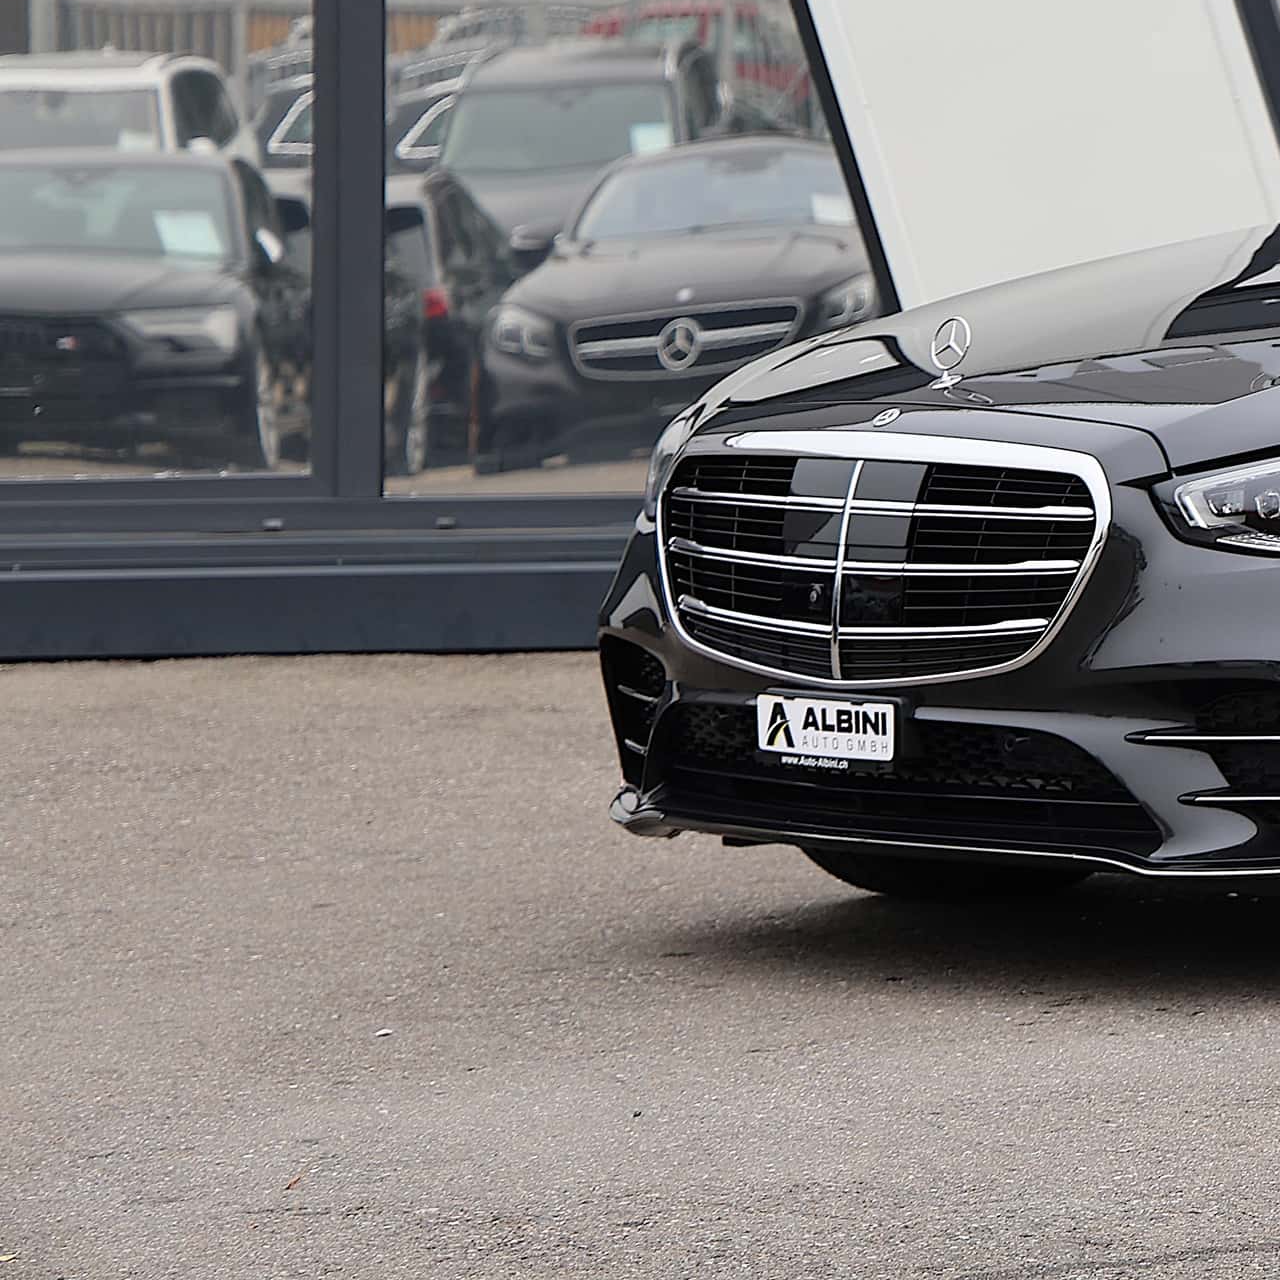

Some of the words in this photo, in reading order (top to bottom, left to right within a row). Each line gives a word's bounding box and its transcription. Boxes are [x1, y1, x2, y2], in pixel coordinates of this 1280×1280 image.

[802, 706, 887, 736] ALBINI
[802, 735, 839, 750] AUTO
[846, 738, 888, 753] GMBH
